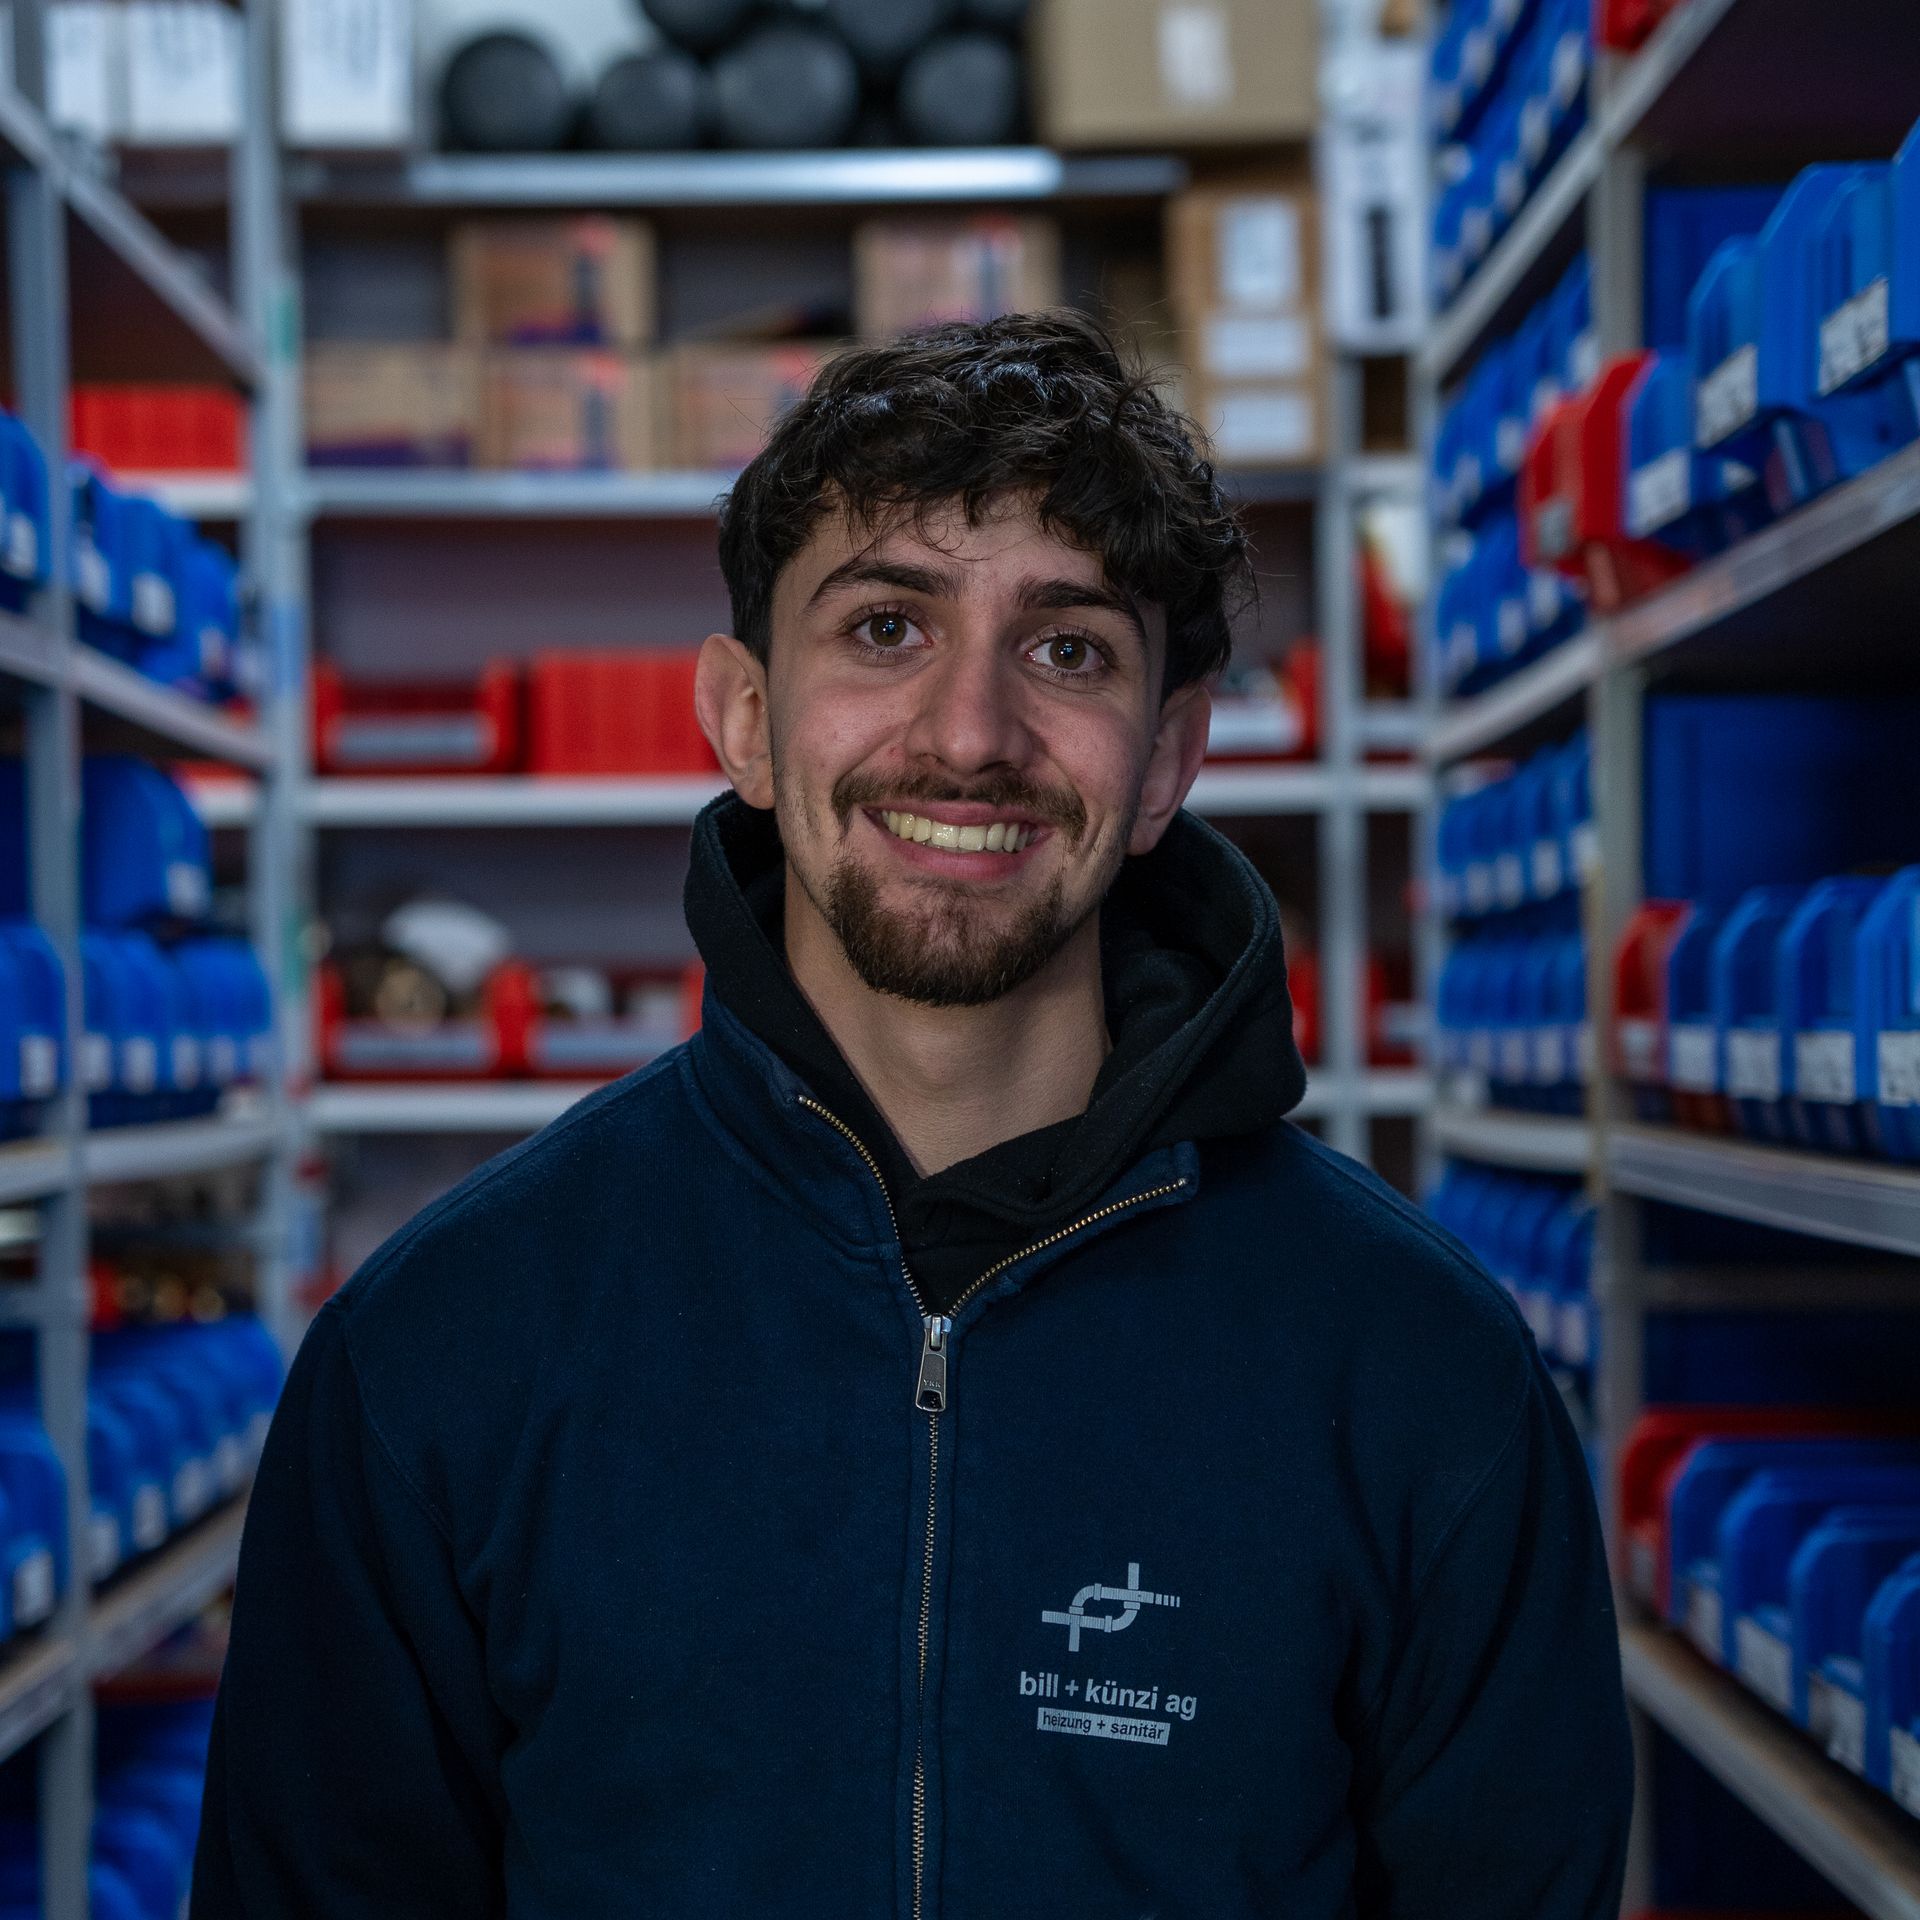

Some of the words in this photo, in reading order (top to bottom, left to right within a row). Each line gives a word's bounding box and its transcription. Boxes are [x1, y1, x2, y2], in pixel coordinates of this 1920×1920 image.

[1019, 1671, 1059, 1698] bill
[1065, 1679, 1079, 1697] +
[1085, 1678, 1159, 1710] künzi
[1165, 1694, 1198, 1721] ag
[1043, 1711, 1092, 1733] heizung
[1097, 1720, 1106, 1730] +
[1110, 1721, 1165, 1740] sanitär
